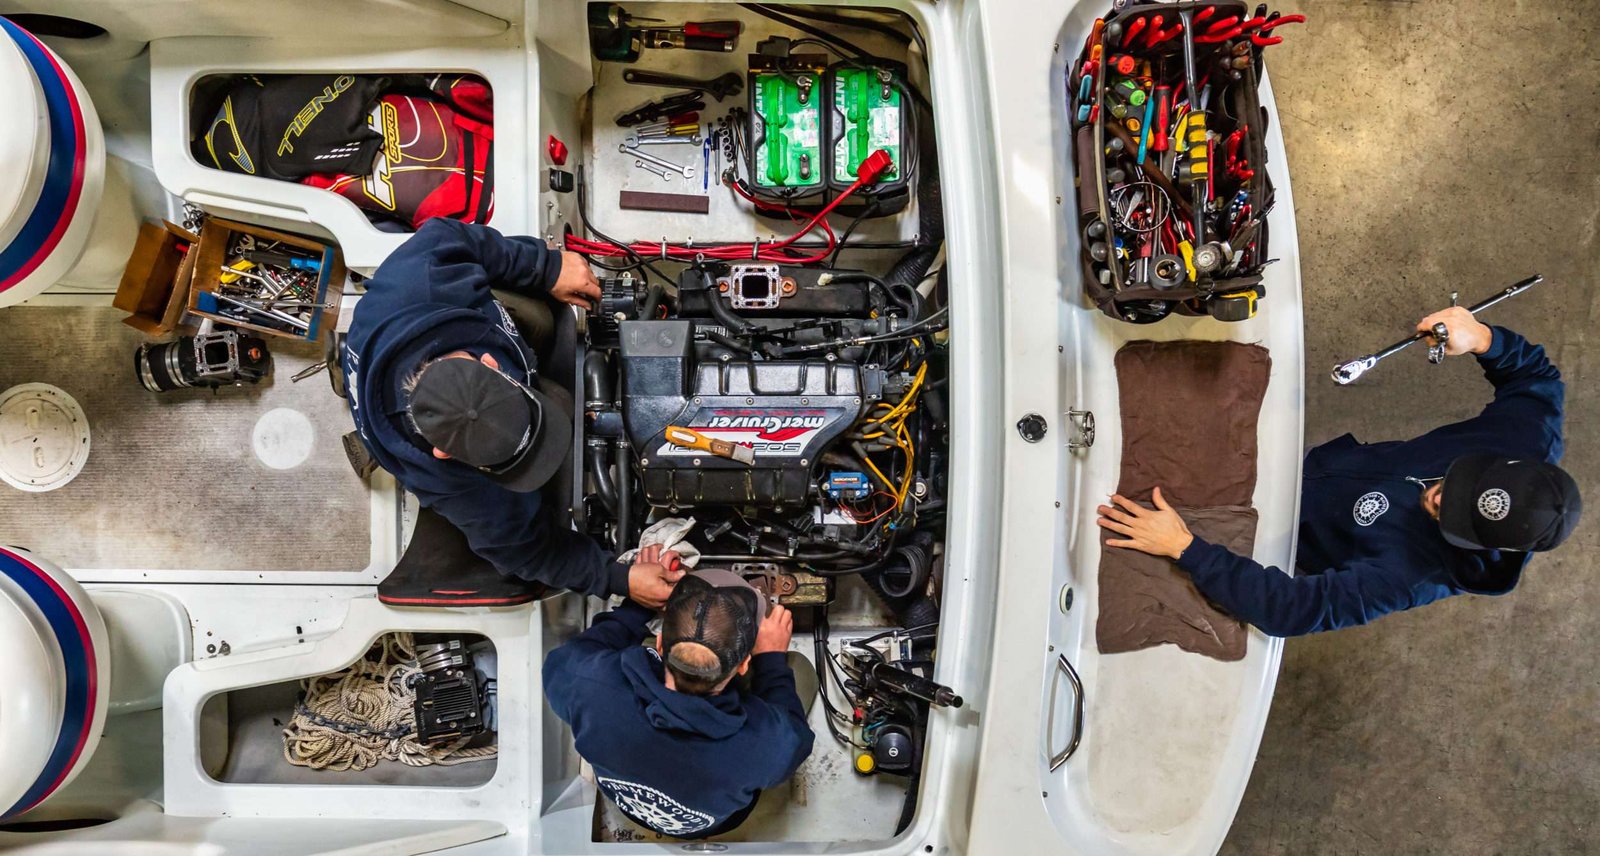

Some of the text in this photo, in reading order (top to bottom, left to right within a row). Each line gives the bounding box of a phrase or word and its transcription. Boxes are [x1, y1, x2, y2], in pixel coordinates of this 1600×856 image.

[277, 74, 355, 157] O'NEILL
[385, 105, 398, 160] SPORTS
[709, 415, 825, 433] merCruiser
[753, 442, 801, 452] 502
[611, 782, 701, 822] HOMEWOOD
